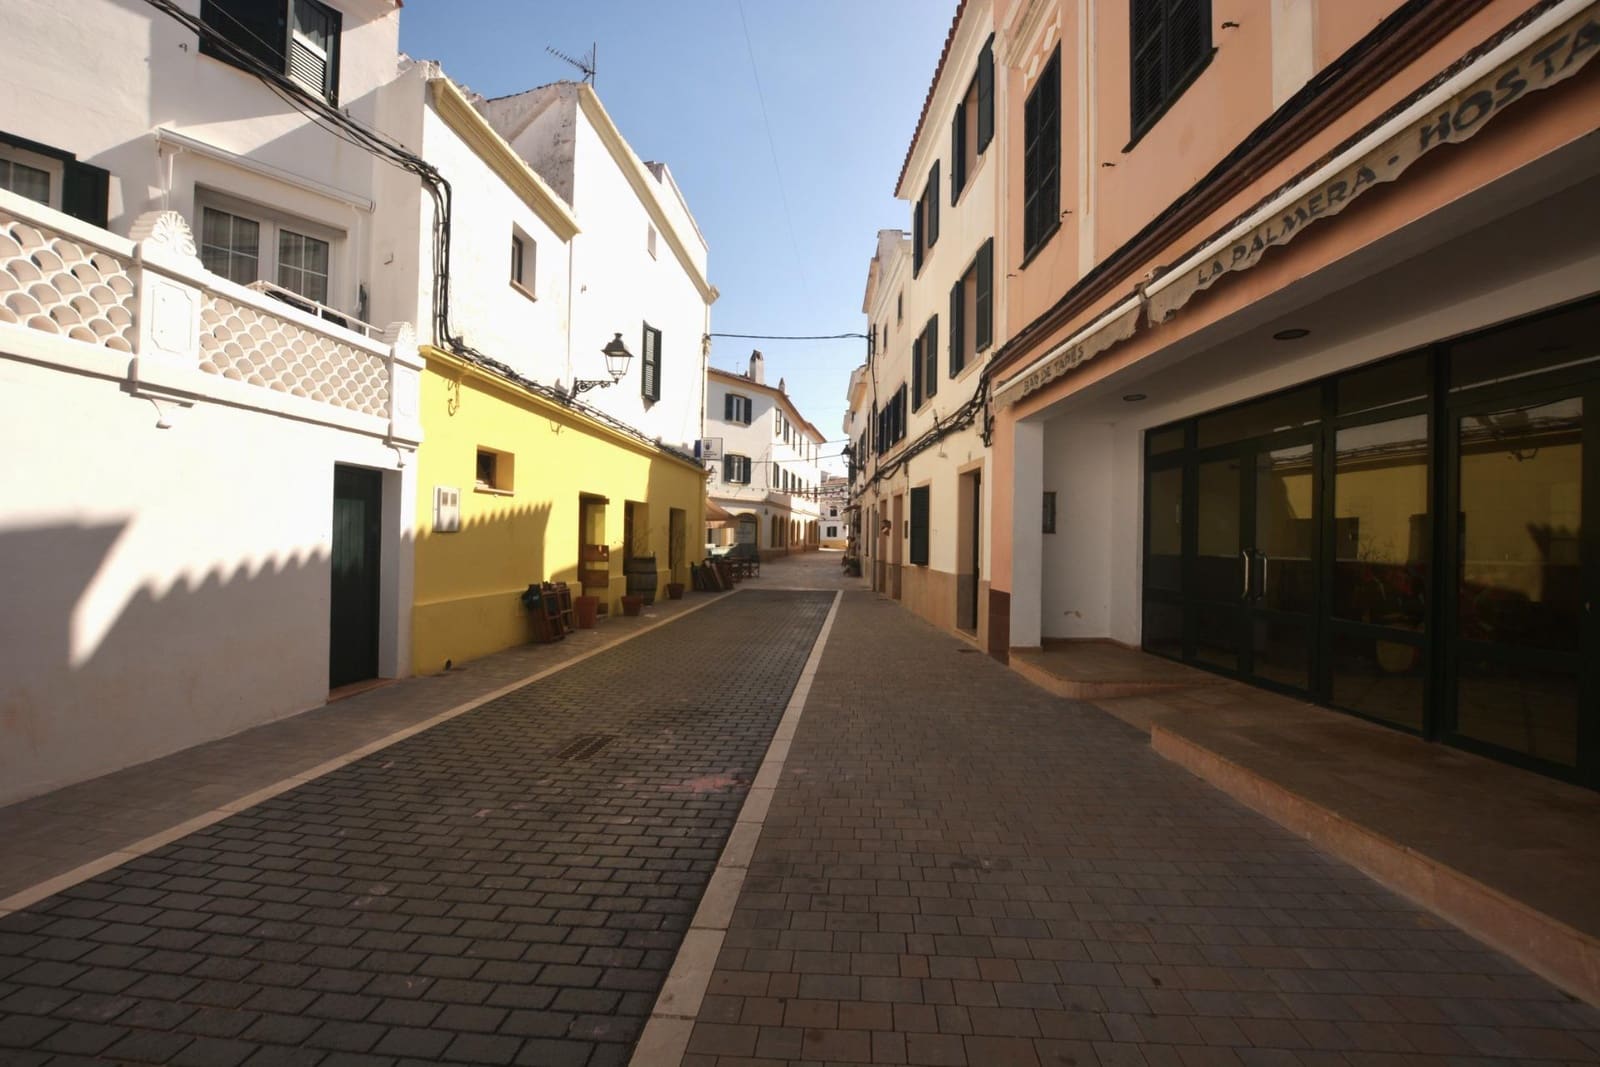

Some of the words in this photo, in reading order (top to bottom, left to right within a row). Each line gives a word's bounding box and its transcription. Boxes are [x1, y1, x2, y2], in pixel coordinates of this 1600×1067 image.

[1197, 260, 1224, 286] LA
[1230, 166, 1377, 268] PALMERA
[1419, 19, 1600, 151] HOSTA
